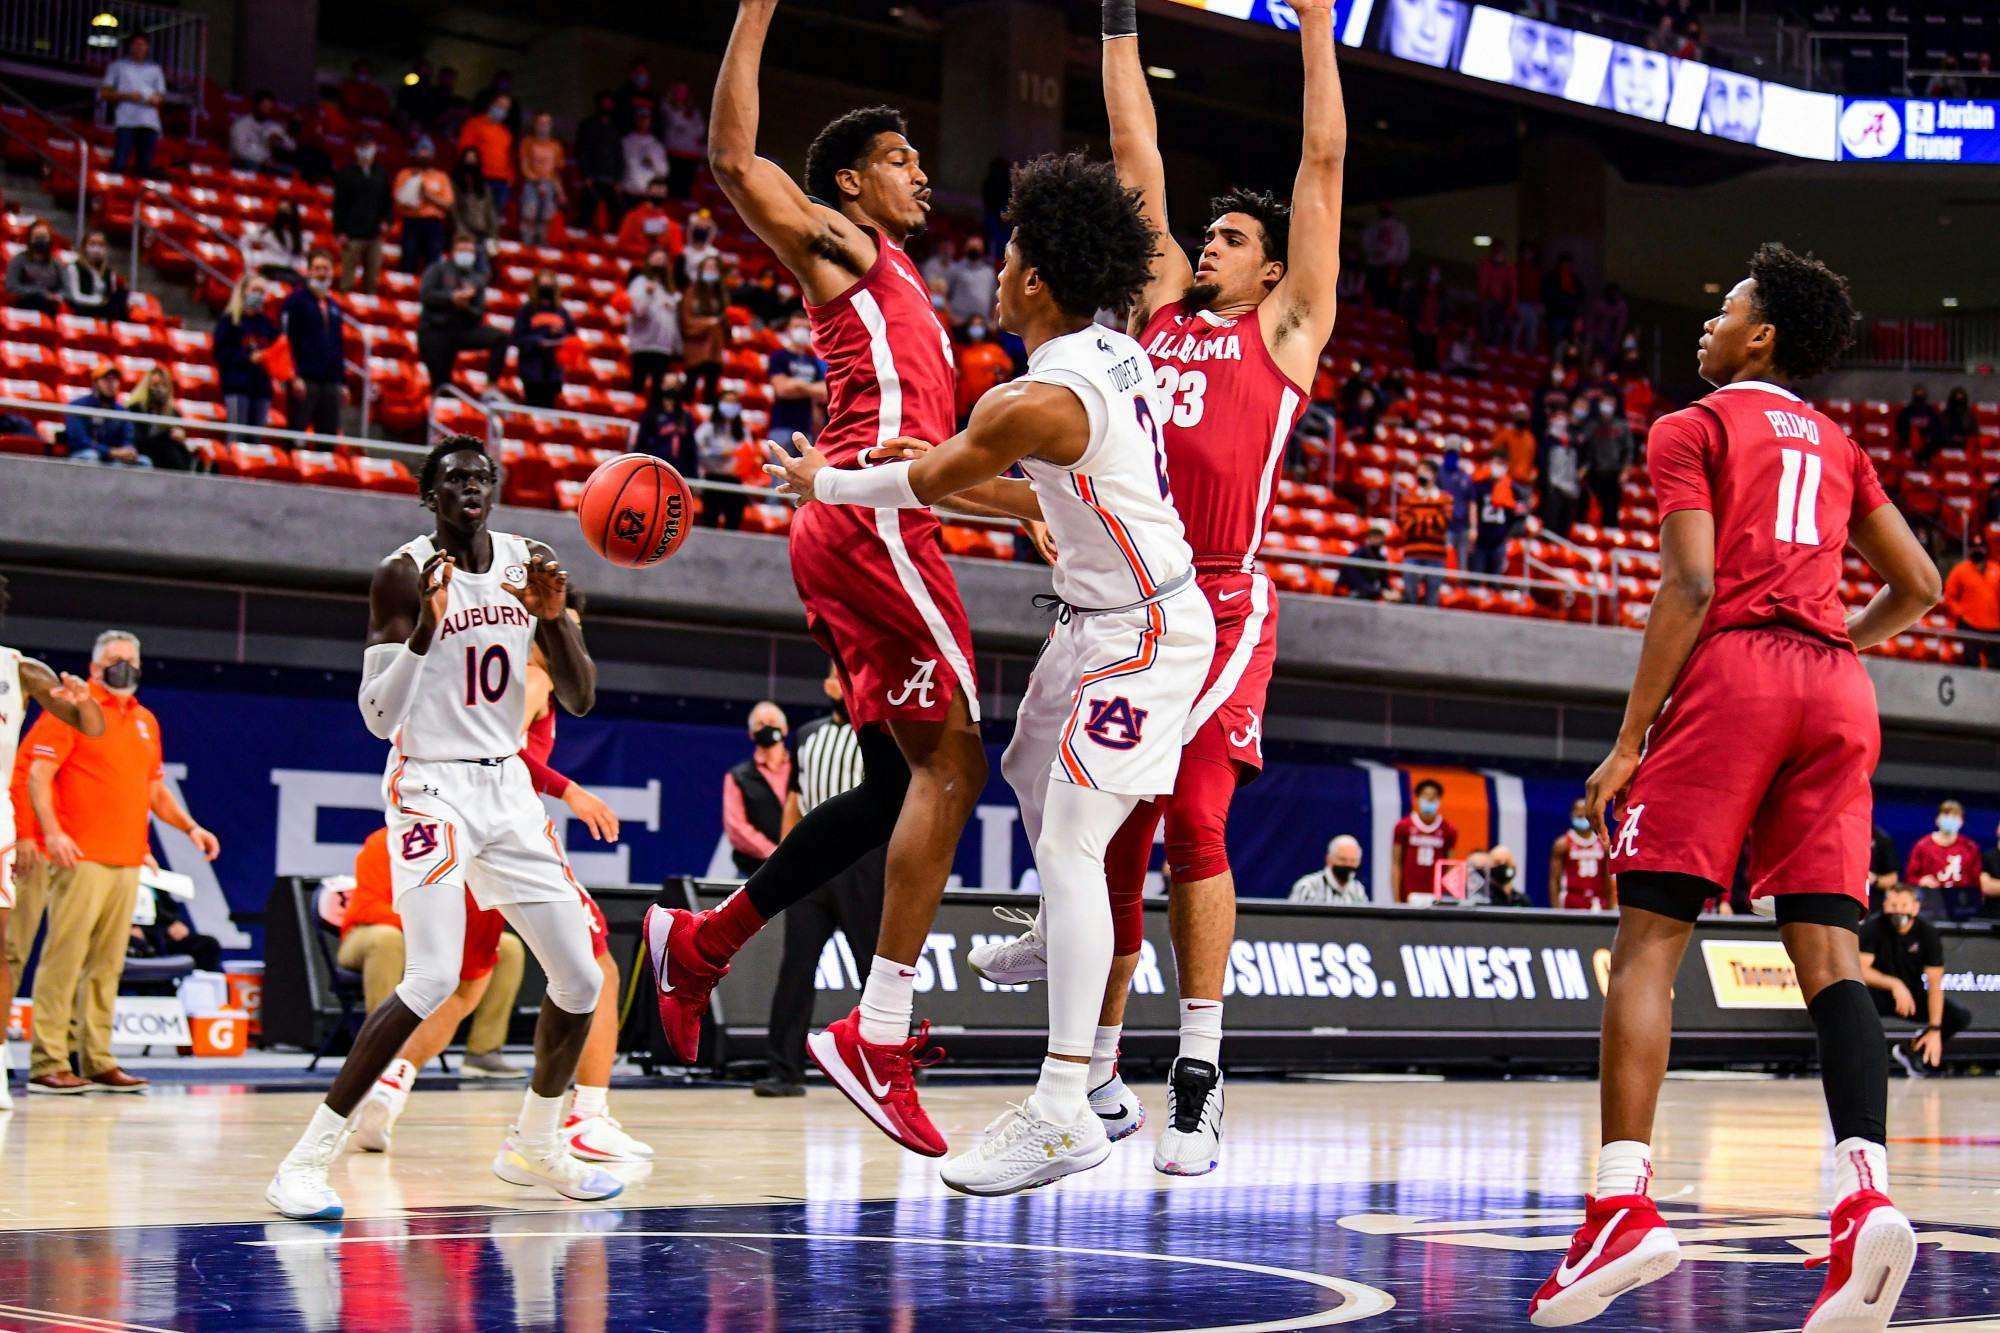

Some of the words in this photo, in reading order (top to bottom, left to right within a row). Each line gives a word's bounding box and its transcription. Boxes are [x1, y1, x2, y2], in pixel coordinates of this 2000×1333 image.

[1017, 71, 1060, 108] 110
[1937, 100, 1995, 129] Jordan
[1905, 134, 1963, 160] Bruner
[1145, 331, 1241, 363] ALABAMA
[1155, 365, 1207, 428] 33
[1133, 394, 1171, 502] 2
[1763, 411, 1820, 446] PRIMO
[1775, 448, 1822, 546] 11
[644, 494, 682, 564] Wilson
[440, 606, 530, 641] AUBURN
[465, 644, 510, 707] 10
[887, 656, 938, 708] A
[1938, 675, 1955, 707] G
[1609, 804, 1645, 859] A
[1222, 940, 1397, 998] SINESS.
[1400, 944, 1537, 1000] INVEST
[1541, 948, 1589, 1000] IN
[209, 1020, 235, 1050] G
